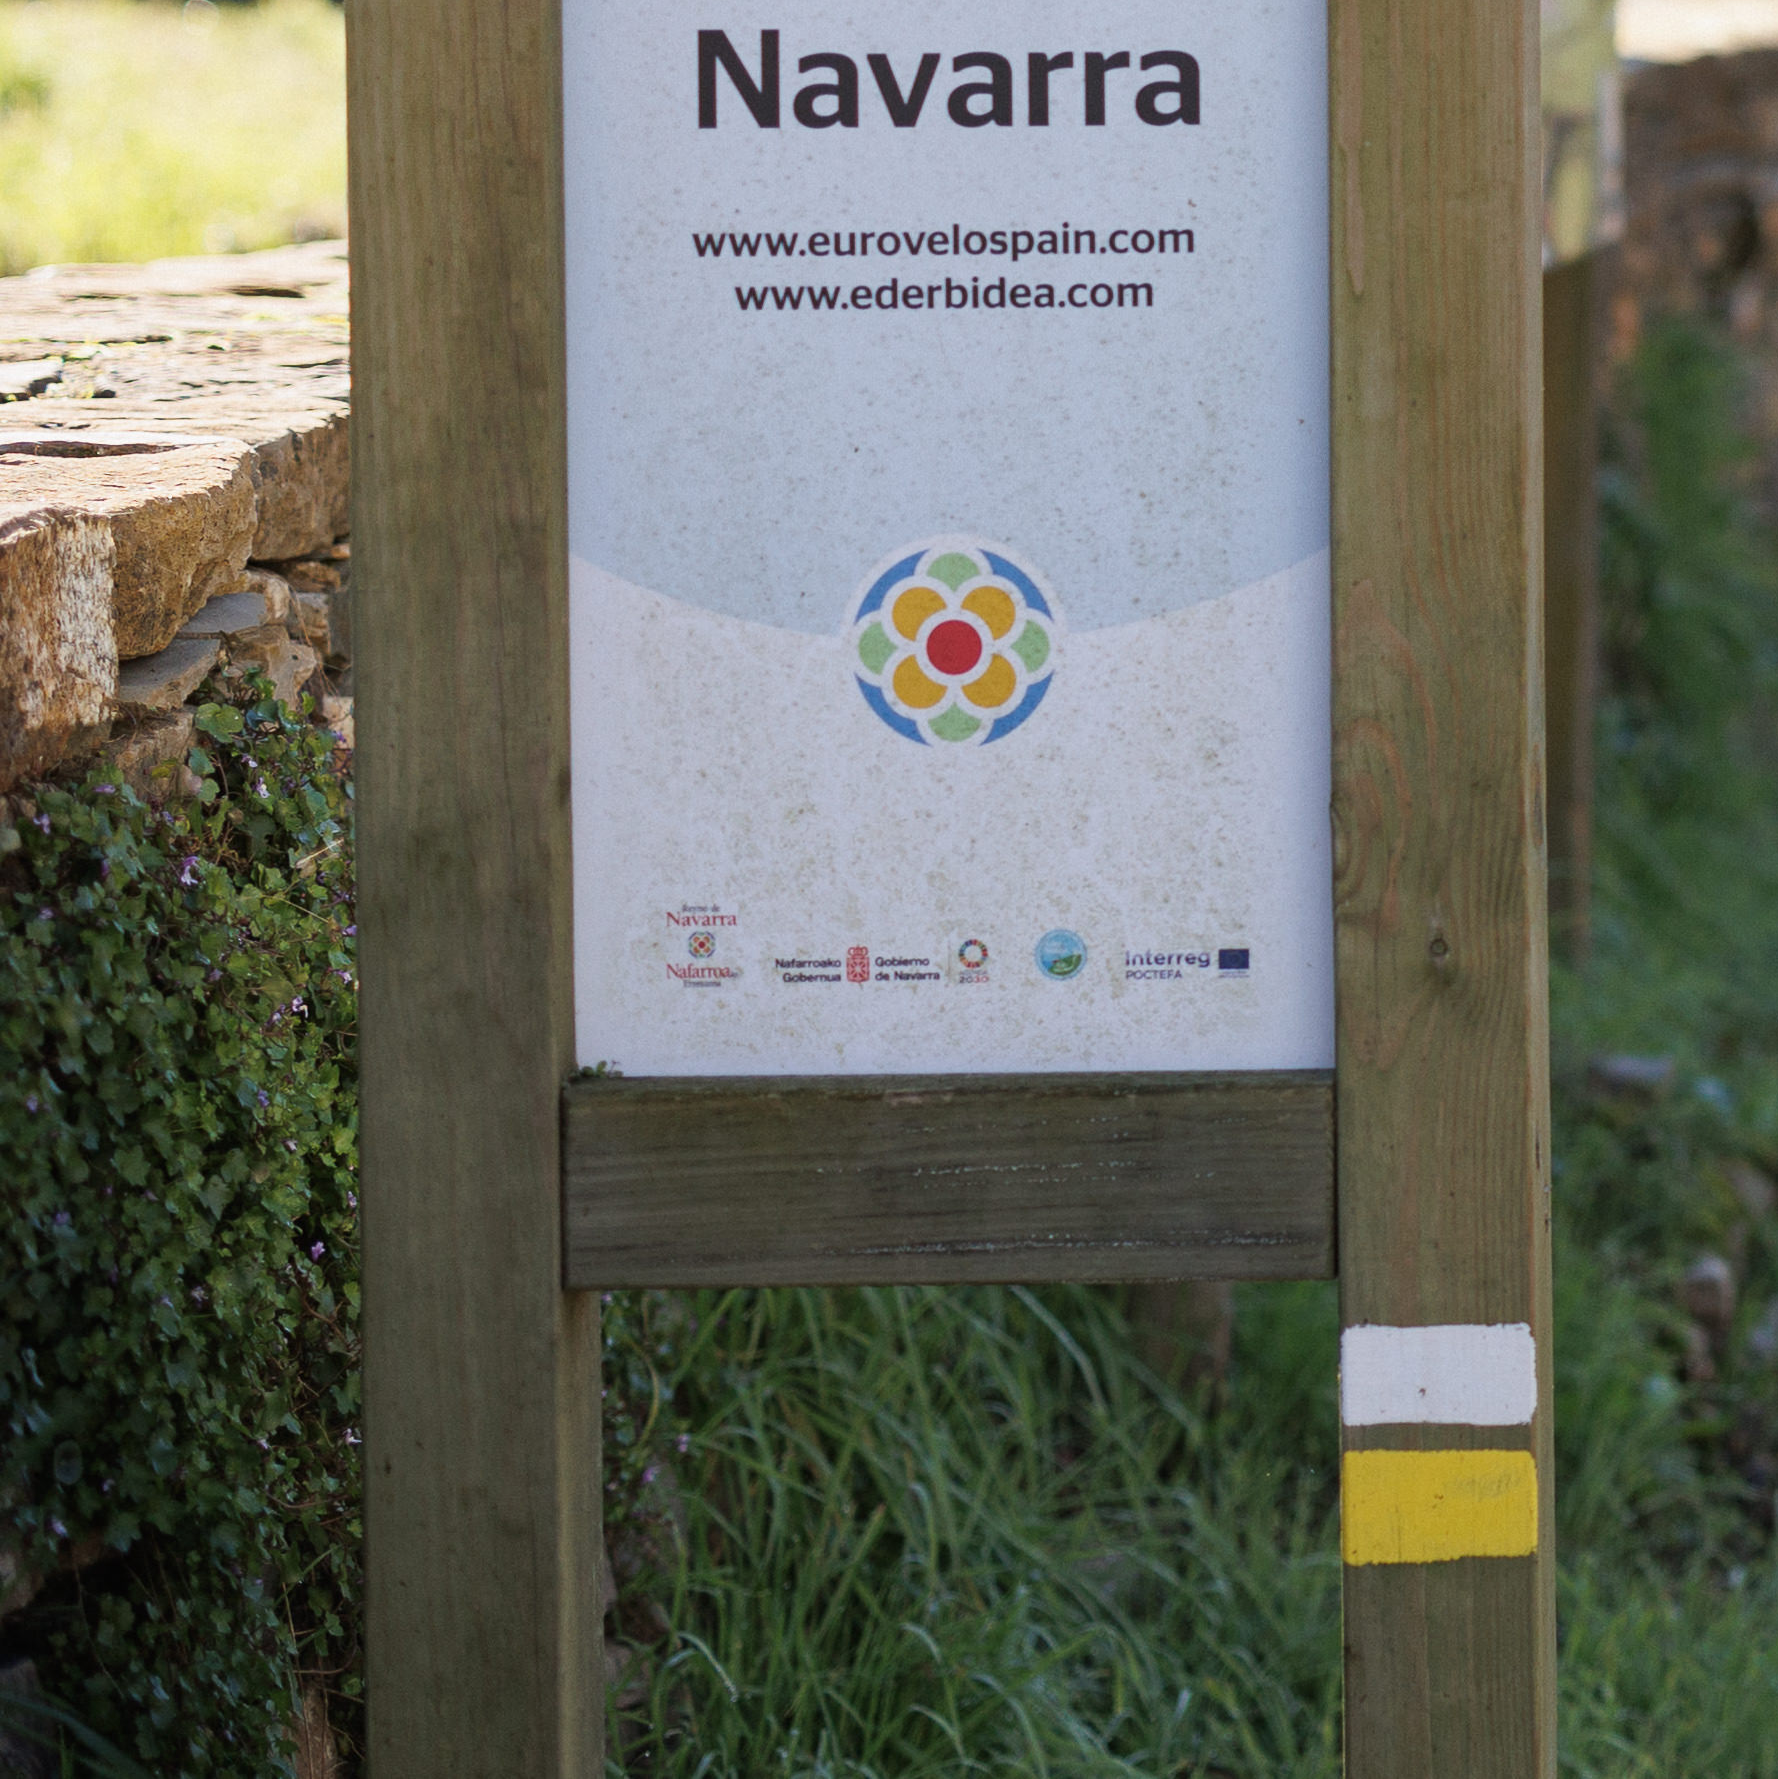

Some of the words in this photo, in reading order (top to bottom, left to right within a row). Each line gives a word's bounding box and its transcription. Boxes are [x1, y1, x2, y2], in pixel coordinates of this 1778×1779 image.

[697, 28, 1201, 130] Navarra
[692, 221, 1195, 262] www.eurovelospain.com
[734, 276, 1154, 312] www.ederbidea.com
[666, 911, 737, 927] Navarra
[775, 957, 842, 969] Nafarroako
[874, 956, 930, 967] Gobierno
[1125, 950, 1210, 968] Interreg
[782, 972, 842, 983] Gobernua
[874, 971, 890, 981] de
[894, 971, 941, 981] Navarra
[959, 974, 990, 984] 2030
[1125, 970, 1183, 980] POCTEFA
